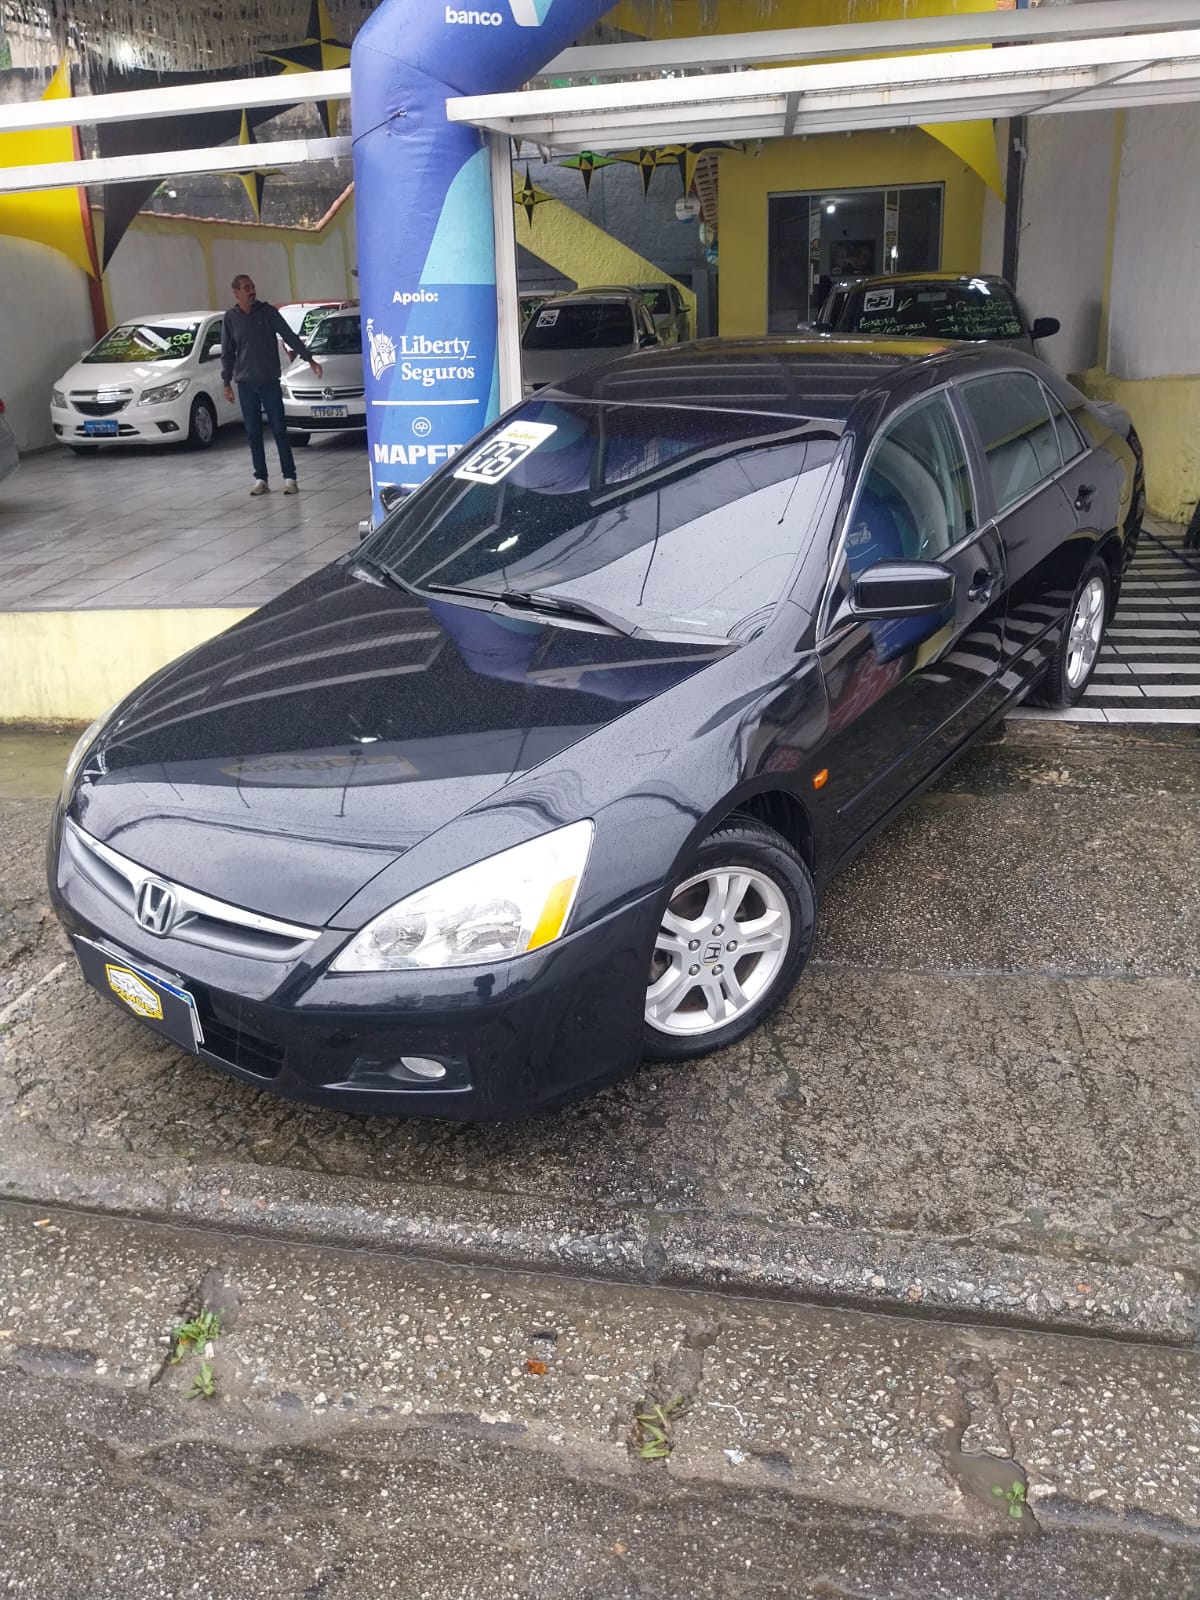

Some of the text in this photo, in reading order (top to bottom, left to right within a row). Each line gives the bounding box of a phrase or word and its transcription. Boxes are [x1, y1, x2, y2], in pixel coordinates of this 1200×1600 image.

[444, 5, 504, 26] banco
[392, 290, 439, 305] Apoio:
[400, 336, 471, 361] Liberty
[401, 363, 475, 387] Seguros
